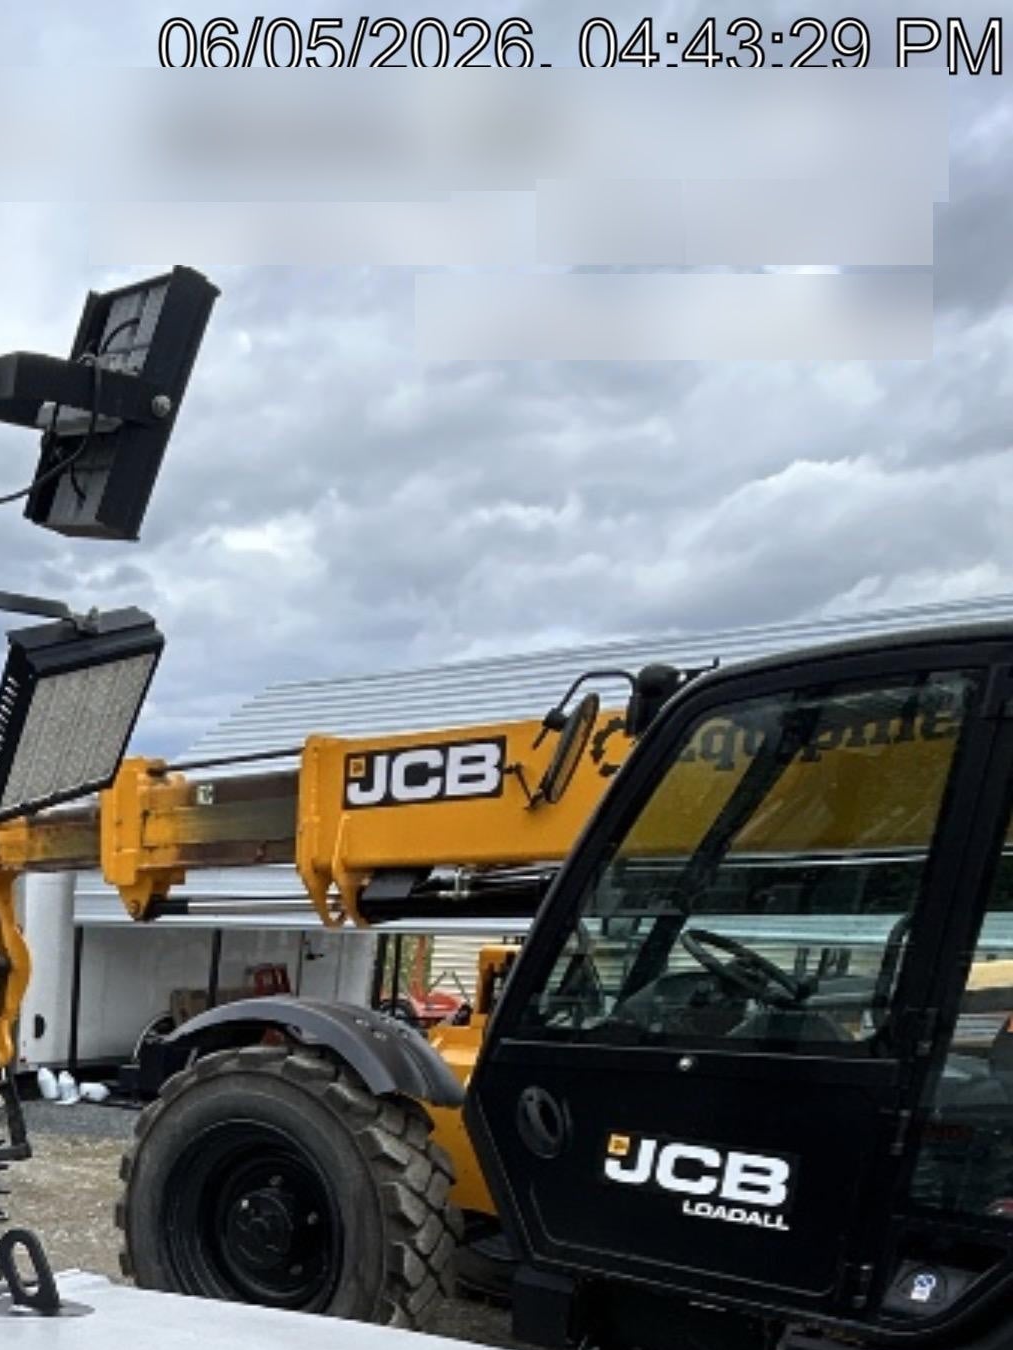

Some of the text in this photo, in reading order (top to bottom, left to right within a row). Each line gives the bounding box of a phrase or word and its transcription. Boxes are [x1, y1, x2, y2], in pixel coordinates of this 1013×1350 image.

[346, 742, 500, 803] JCB
[604, 1138, 790, 1207] JCB
[682, 1199, 790, 1231] LOADALL
